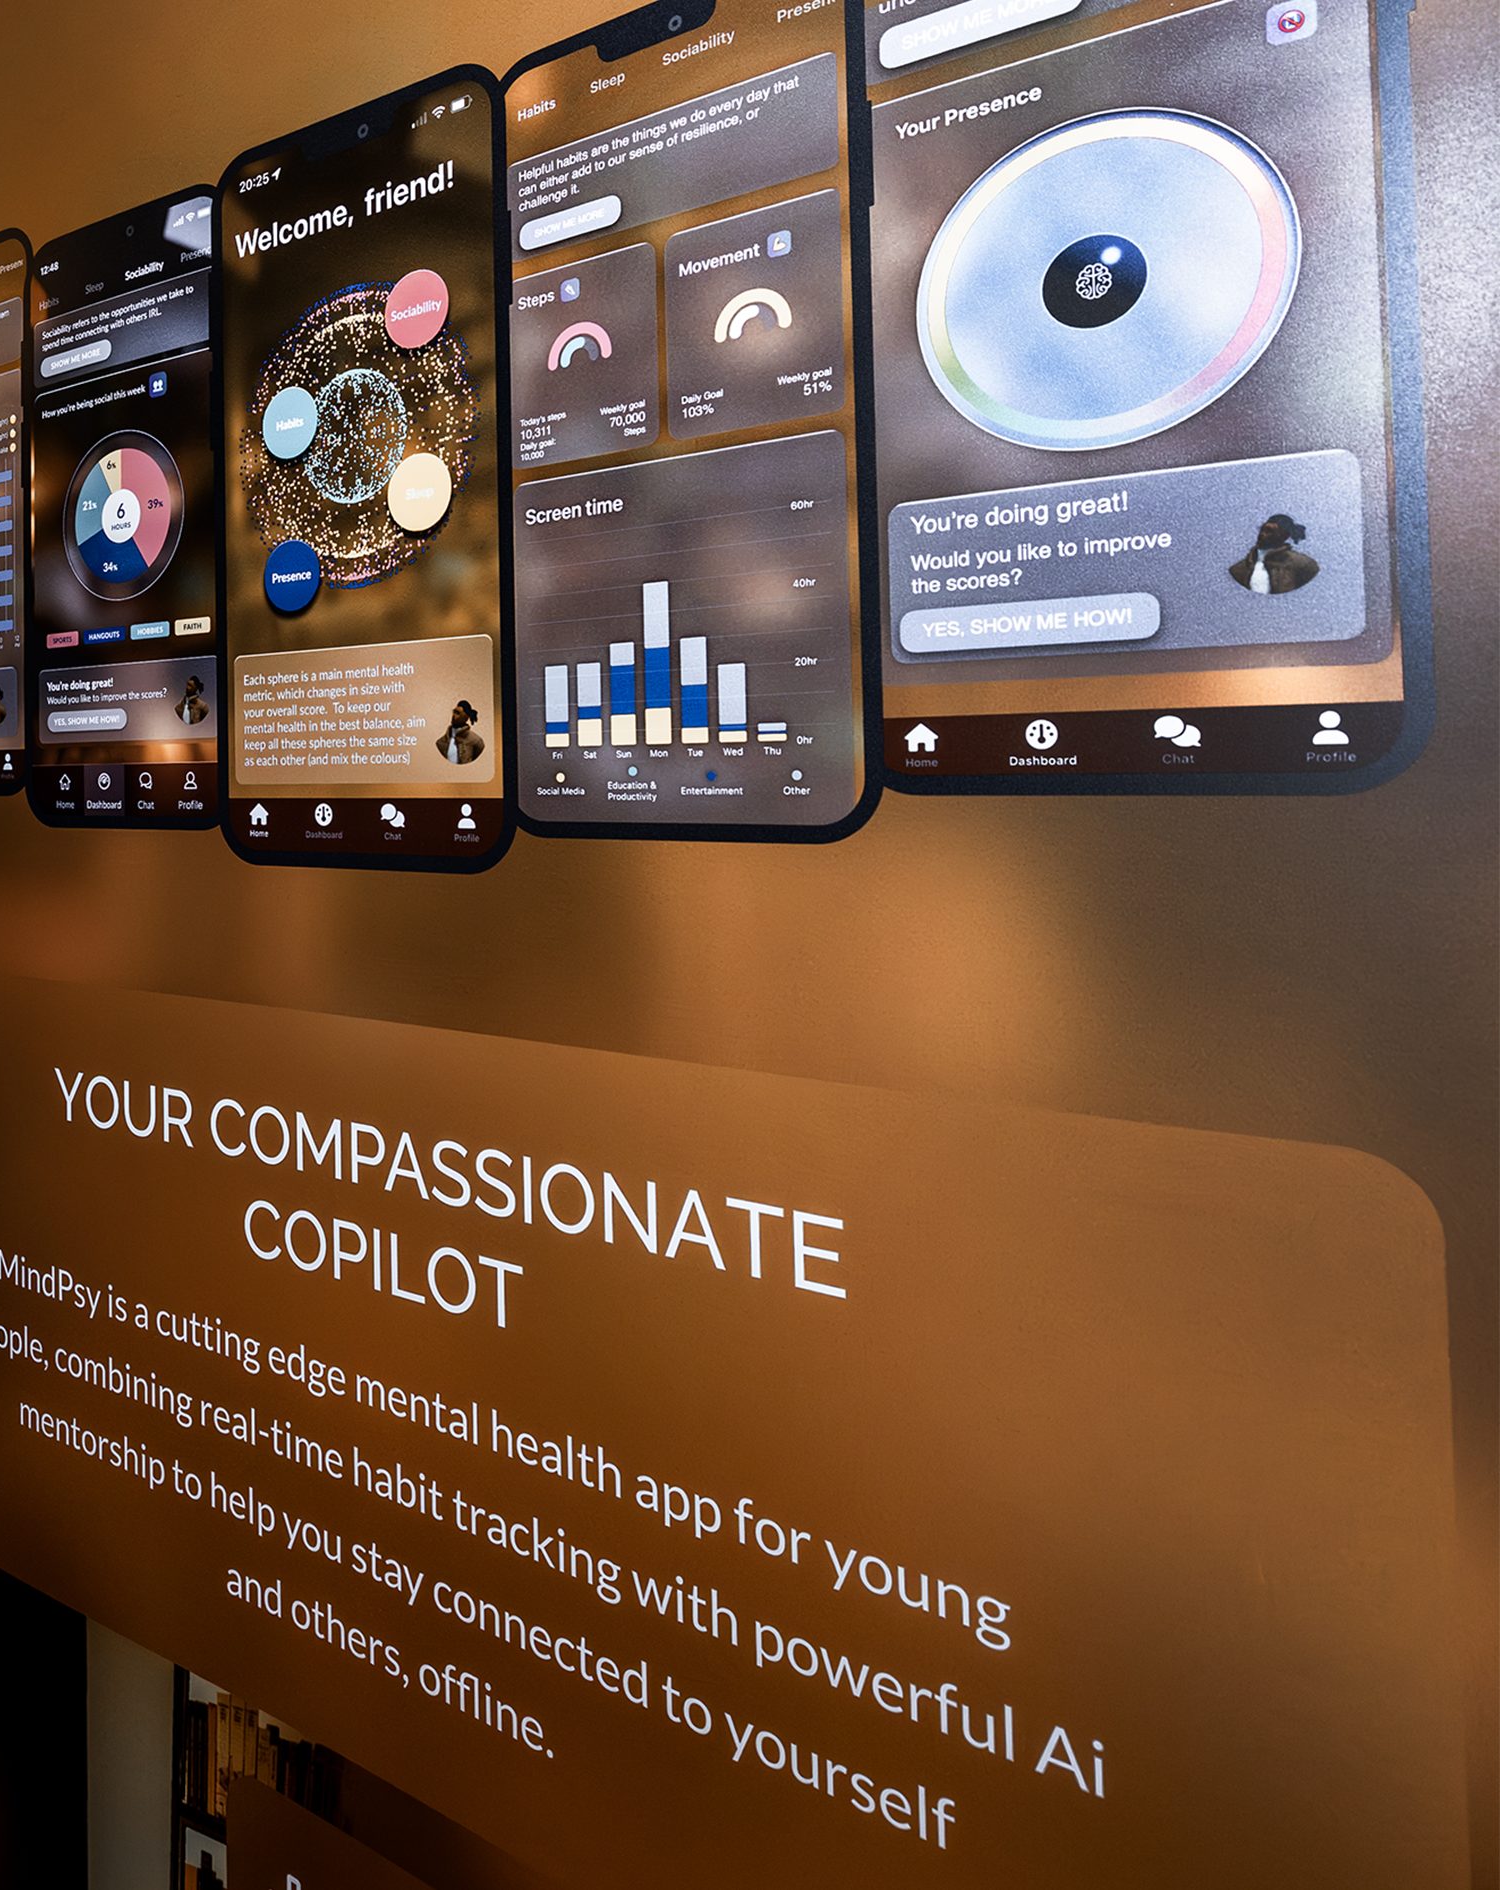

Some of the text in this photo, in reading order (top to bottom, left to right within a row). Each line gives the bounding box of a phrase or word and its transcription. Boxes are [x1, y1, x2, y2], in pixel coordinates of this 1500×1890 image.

[901, 18, 958, 50] SHOW
[963, 9, 994, 32] ME
[517, 0, 836, 122] Habits Sleep Sociability Presen
[895, 86, 1043, 140] Your Presence
[518, 75, 800, 183] Helpful habits are the things we do every day that
[518, 107, 760, 198] can either add to our sense of resilience, or
[239, 172, 270, 194] 20:25
[518, 184, 580, 212] challenge it.
[234, 159, 455, 259] Welcome, friend!
[678, 243, 761, 277] Movement
[124, 261, 165, 282] Sociability
[517, 289, 555, 311] Steps
[390, 299, 442, 322] Sociability
[777, 366, 833, 387] Weekly goal
[803, 380, 832, 396] 51%
[681, 389, 724, 405] Daily Goal
[599, 399, 646, 416] Weekly goal
[681, 403, 715, 419] 103%
[276, 417, 304, 432] Habits
[520, 412, 567, 427] Today's steps
[609, 411, 646, 428] 70,000
[520, 425, 551, 440] 10,311
[624, 426, 646, 437] Steps
[520, 441, 538, 452] Daily
[520, 450, 545, 461] 10,000
[117, 503, 126, 519] 6
[525, 497, 624, 526] Screen time
[790, 499, 814, 511] 60hr
[985, 503, 1049, 527] doing
[1056, 490, 1129, 523] great!
[111, 522, 132, 531] HOURS
[910, 532, 1172, 571] Would you like to improve
[271, 570, 312, 584] Presence
[793, 577, 816, 588] 40hr
[911, 568, 1023, 594] the scores?
[183, 623, 202, 632] FAITH
[923, 608, 1132, 639] YES, SHOW ME HOW!
[88, 631, 120, 641] HANGOUTS
[794, 656, 818, 666] 20hr
[796, 735, 813, 745] 0hr
[552, 746, 782, 759] Fri Sat Sun Mon Tue Wed Thu
[905, 749, 1357, 768] Home Dashboard Chat Profile
[537, 787, 585, 795] Social Media
[607, 781, 657, 790] Education &
[680, 786, 743, 795] Entertainment
[783, 786, 811, 795] Other
[56, 800, 203, 810] Home Dashboard Chat Profile
[608, 792, 658, 802] Productivity
[250, 829, 480, 843] Home Dashboard Chat Profile
[54, 1067, 847, 1299] YOUR COMPASSIONATE
[243, 1199, 524, 1328] COPILOT
[108, 1284, 127, 1321] is
[135, 1303, 149, 1329] a
[156, 1309, 260, 1374] cutting
[269, 1344, 346, 1398] edge
[356, 1373, 478, 1446] mental
[491, 1408, 622, 1497] health
[636, 1474, 721, 1538] app
[734, 1498, 811, 1564] for
[825, 1540, 1011, 1651] young
[55, 1347, 193, 1428] combining
[201, 1397, 343, 1479] real-time
[353, 1446, 443, 1520] habit
[453, 1490, 622, 1605] tracking
[632, 1569, 739, 1646] with
[755, 1621, 1014, 1761] powerful
[1035, 1726, 1104, 1798] Ai
[19, 1401, 955, 1849] mentorship to help you stay connected to yourself
[226, 1568, 554, 1758] and others, offline.
